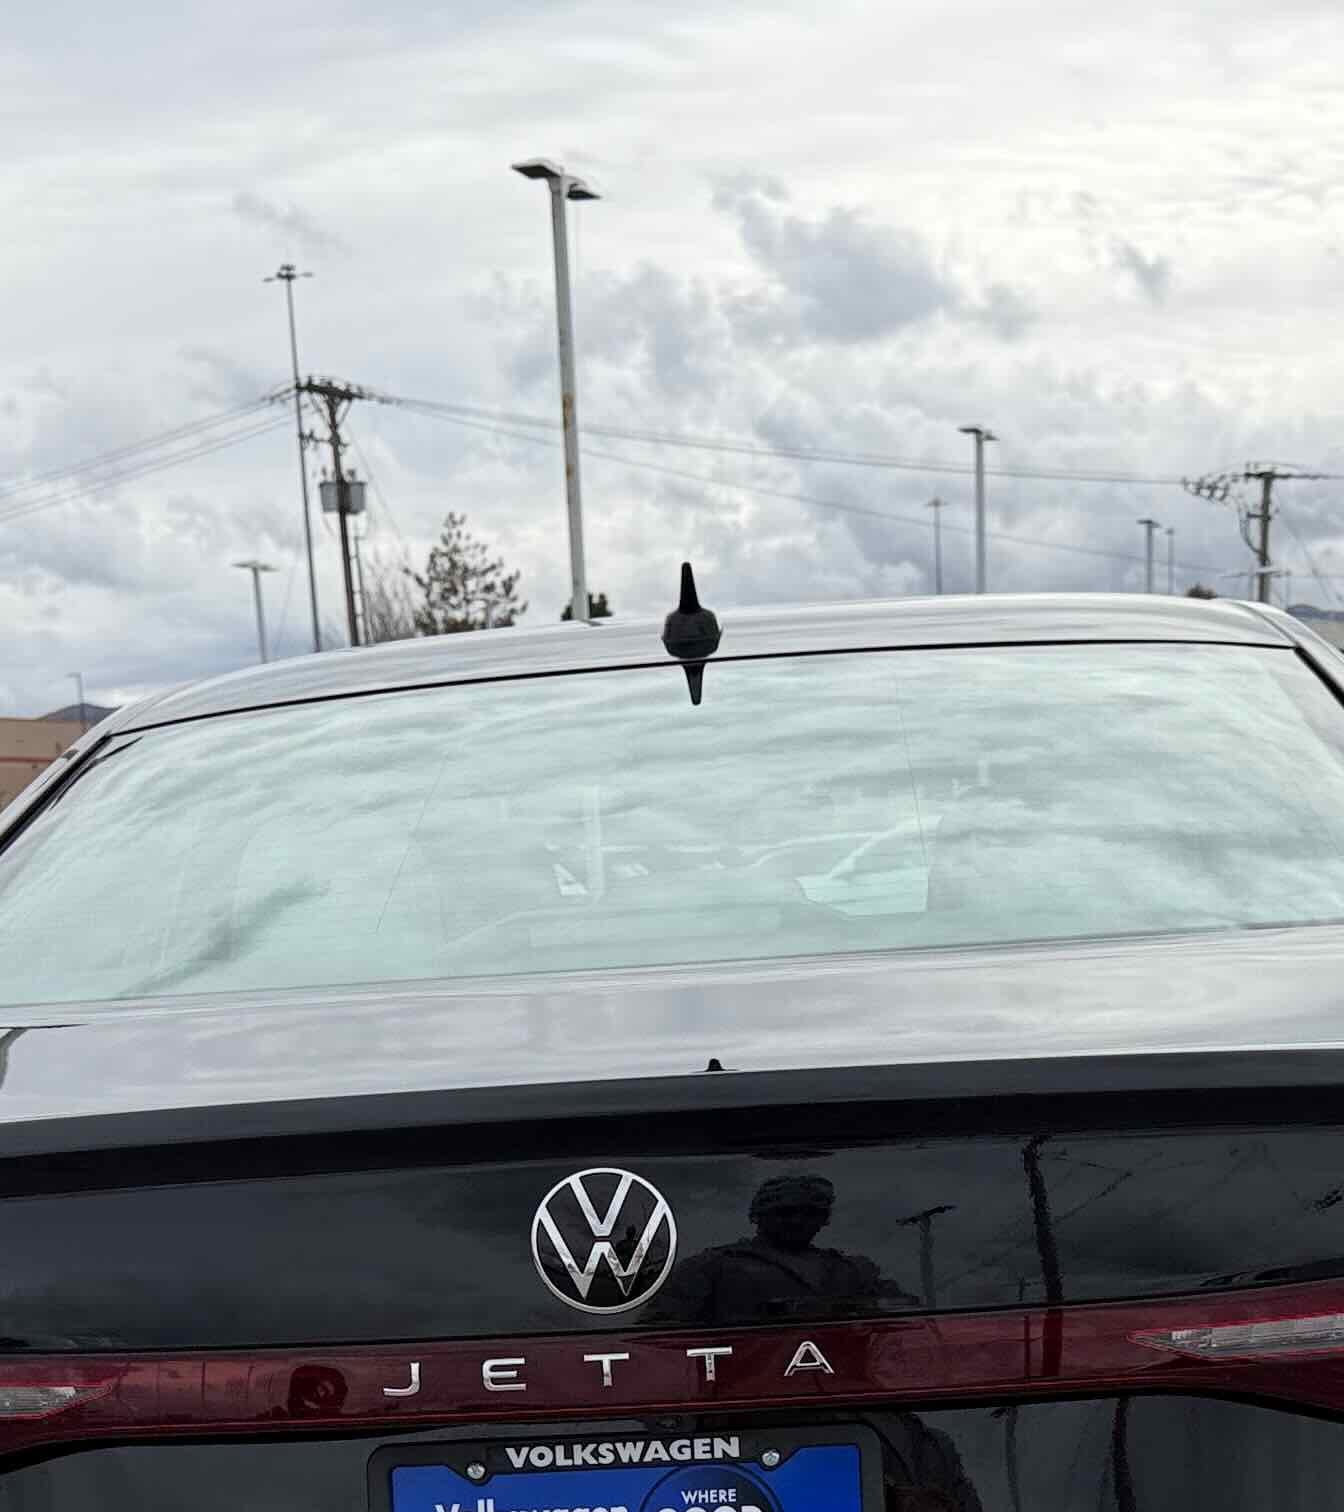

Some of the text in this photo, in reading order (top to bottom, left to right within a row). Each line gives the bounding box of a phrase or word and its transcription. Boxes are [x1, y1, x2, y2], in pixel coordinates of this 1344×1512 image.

[383, 1340, 835, 1397] JETTA
[505, 1436, 741, 1469] VOLKSWAGEN
[680, 1487, 738, 1504] WHERE
